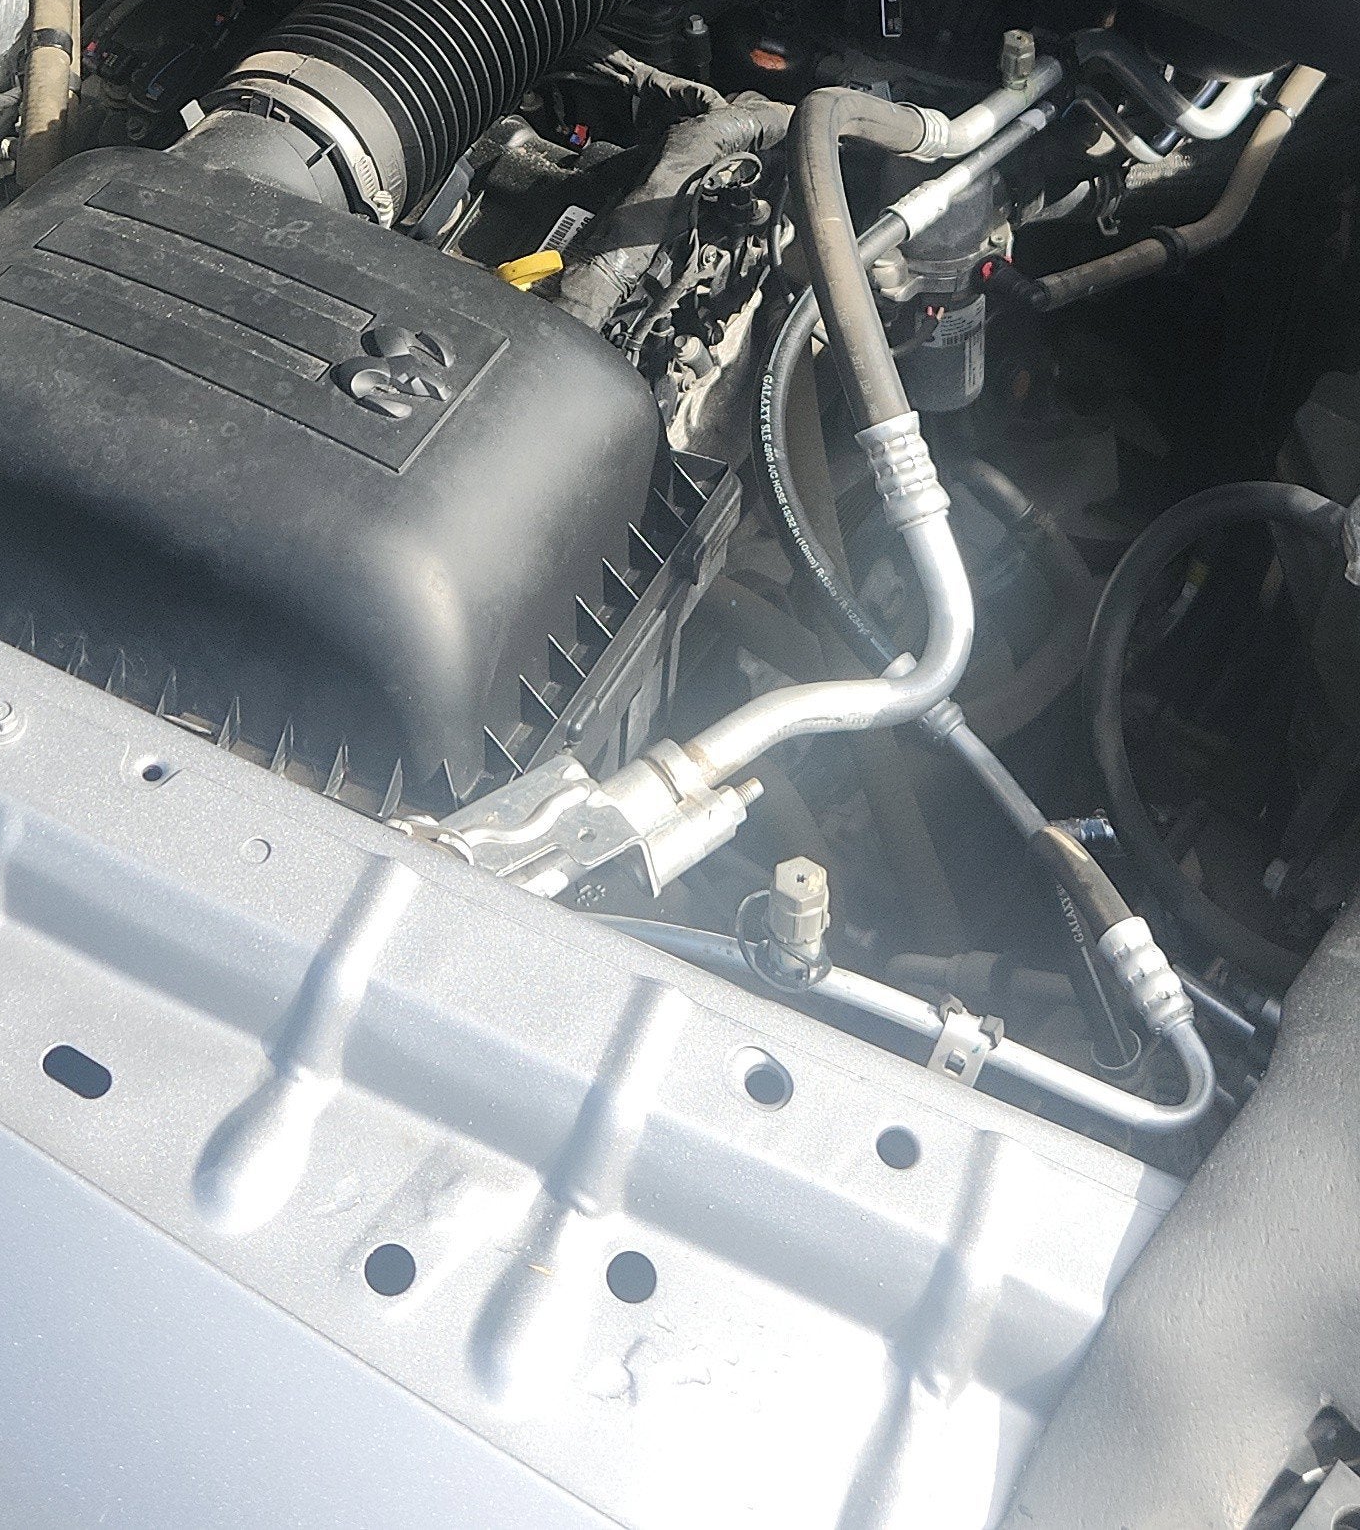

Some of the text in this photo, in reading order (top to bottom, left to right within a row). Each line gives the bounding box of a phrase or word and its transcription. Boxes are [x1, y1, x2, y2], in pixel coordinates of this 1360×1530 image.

[760, 374, 773, 423] GALAXY
[760, 423, 772, 442] SLE
[772, 479, 788, 505] HOSE
[795, 537, 819, 569] (10mm)
[1060, 895, 1084, 945] GALAXY
